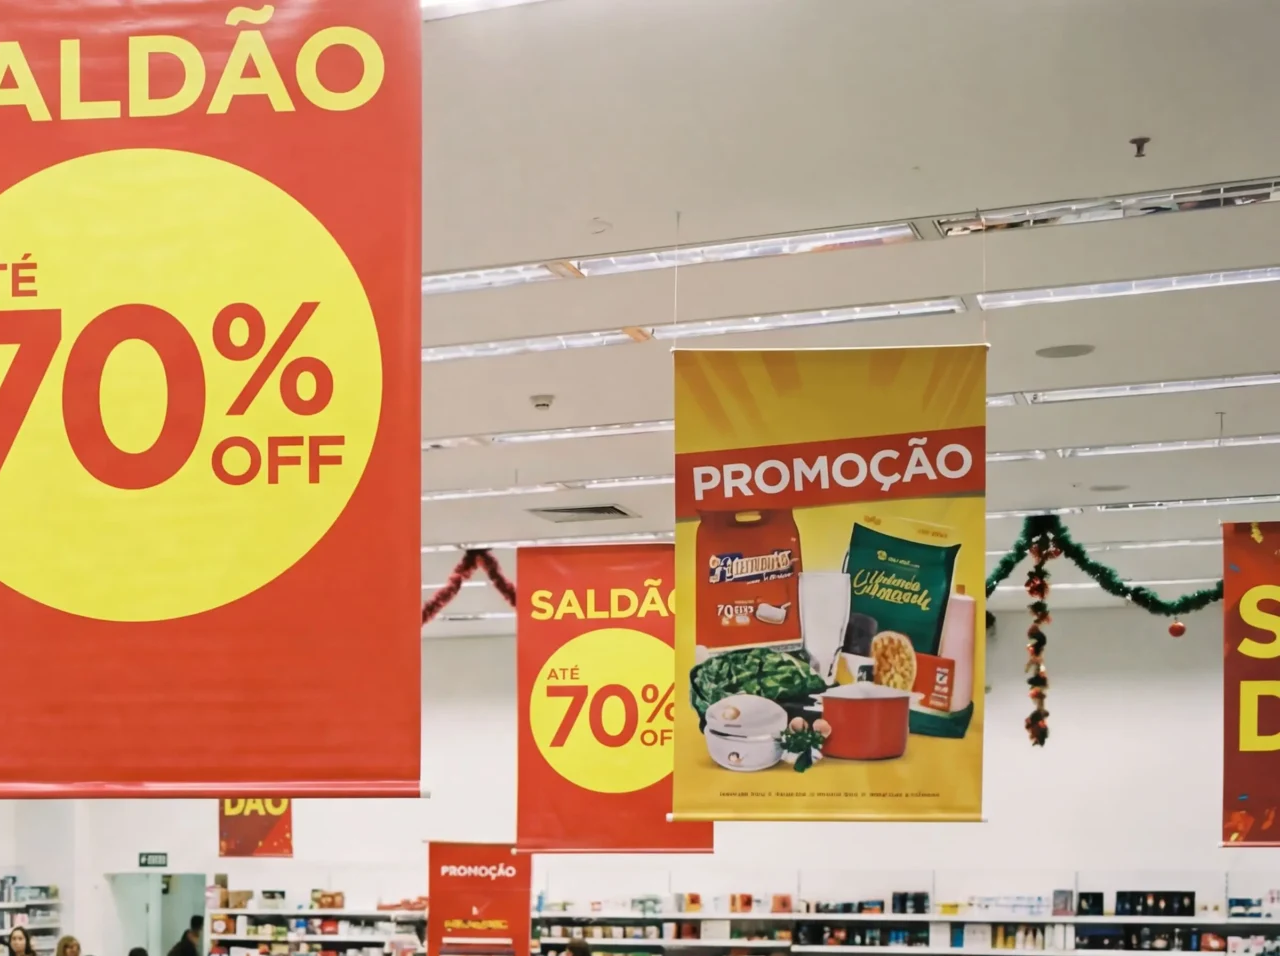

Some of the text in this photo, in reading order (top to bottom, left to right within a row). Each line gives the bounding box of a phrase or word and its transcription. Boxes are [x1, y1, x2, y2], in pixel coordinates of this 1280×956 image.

[211, 435, 345, 485] OFF
[692, 438, 973, 501] PROMOÇÃO
[530, 578, 675, 620] SALDÃ
[547, 665, 580, 680] ATÉ
[640, 729, 673, 746] OF
[441, 863, 516, 880] PROMOÇÃO
